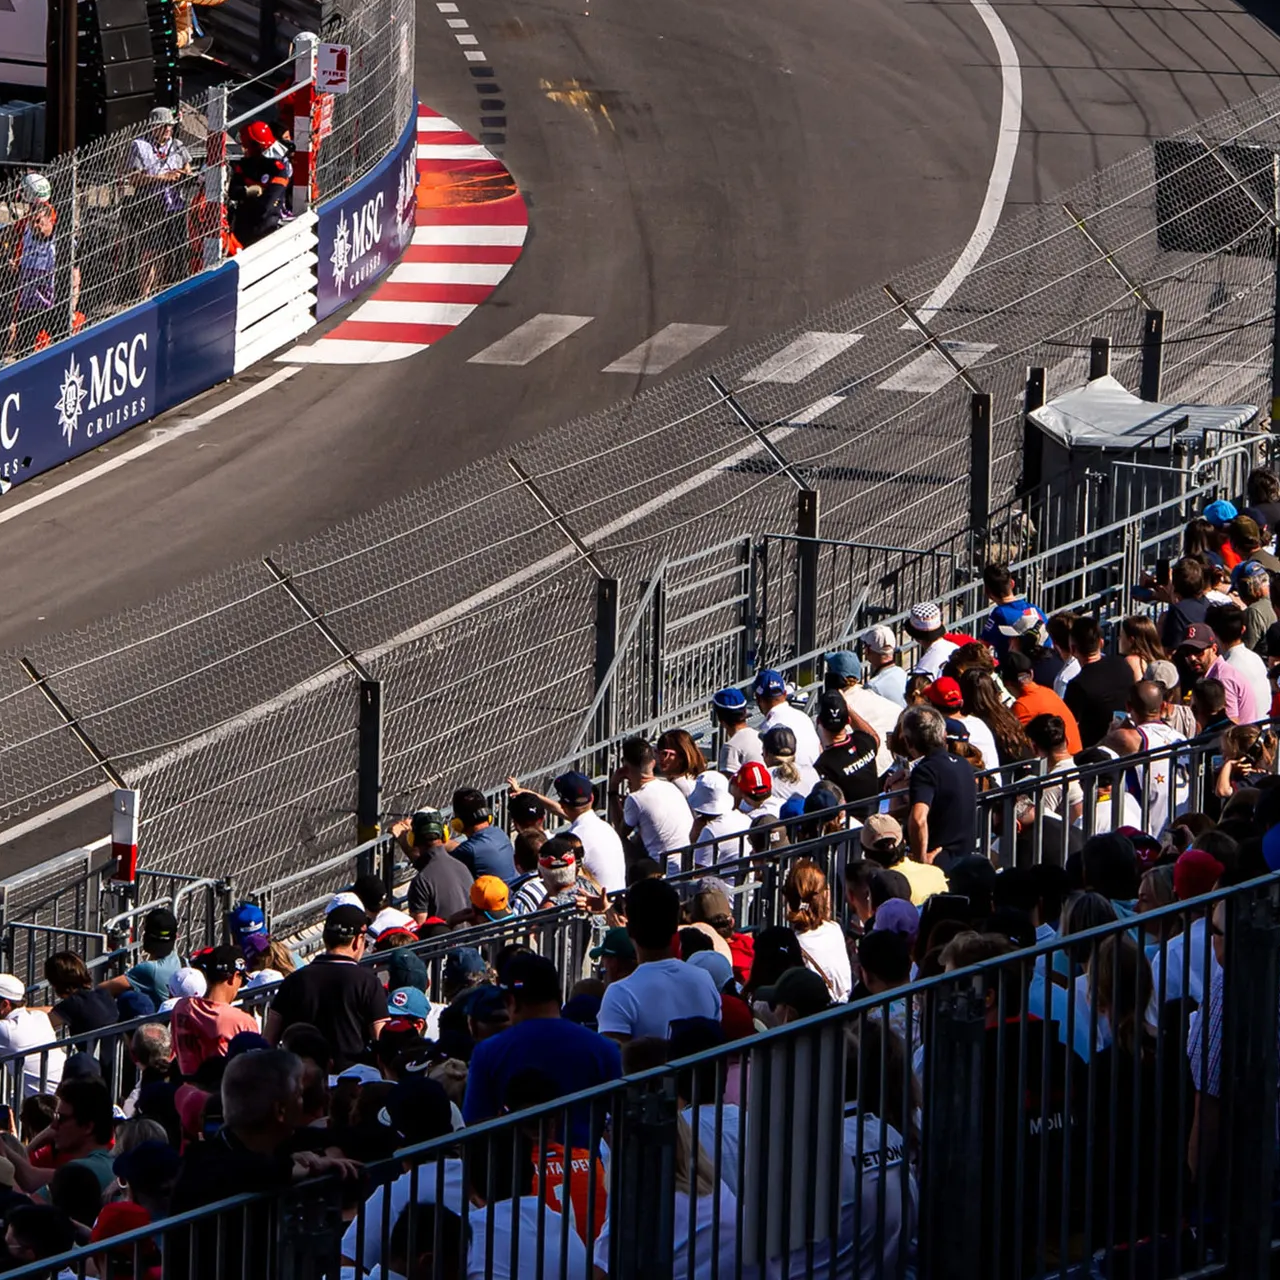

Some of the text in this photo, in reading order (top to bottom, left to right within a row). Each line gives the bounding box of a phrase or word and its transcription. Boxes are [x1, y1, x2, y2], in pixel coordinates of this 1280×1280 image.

[351, 192, 383, 263] MSC
[350, 252, 380, 288] CRUISES
[88, 333, 146, 411] MSC
[87, 392, 145, 437] CRUISES
[843, 749, 875, 775] PETRONAS
